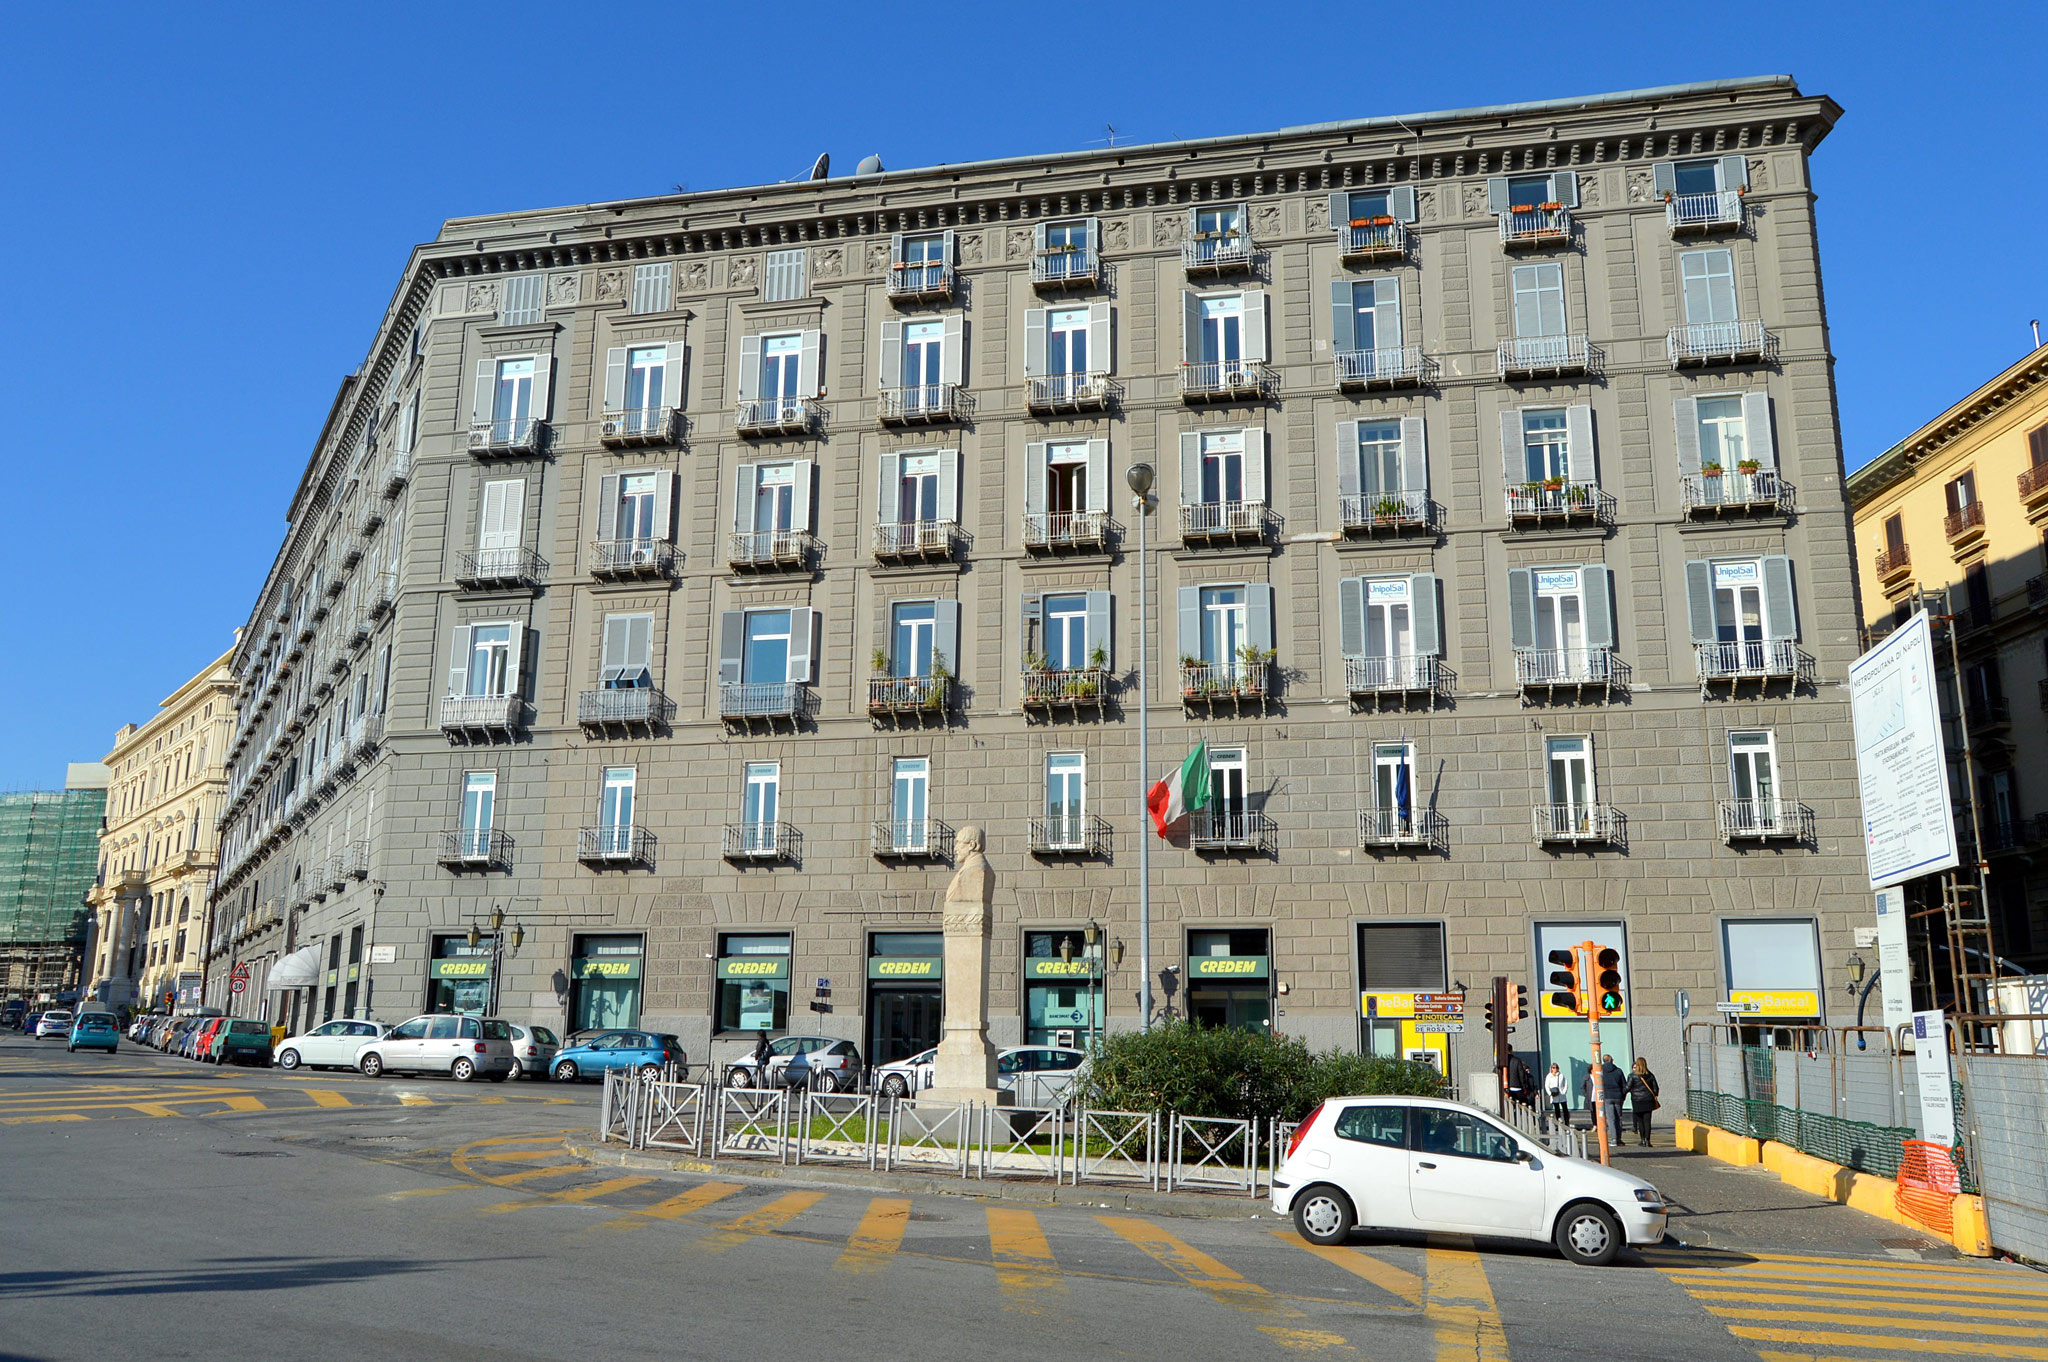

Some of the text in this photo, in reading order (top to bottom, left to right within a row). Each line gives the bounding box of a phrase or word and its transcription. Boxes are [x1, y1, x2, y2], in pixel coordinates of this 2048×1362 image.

[1715, 566, 1753, 577] UnipolSai
[1537, 574, 1574, 586] UnipolSai
[1368, 584, 1404, 595] UnipolSai
[439, 963, 487, 975] CREDEM
[582, 963, 631, 975] CREDEM
[727, 962, 778, 974] CREDEM
[879, 962, 932, 974] CREDEM
[1199, 960, 1256, 973] CREDEM
